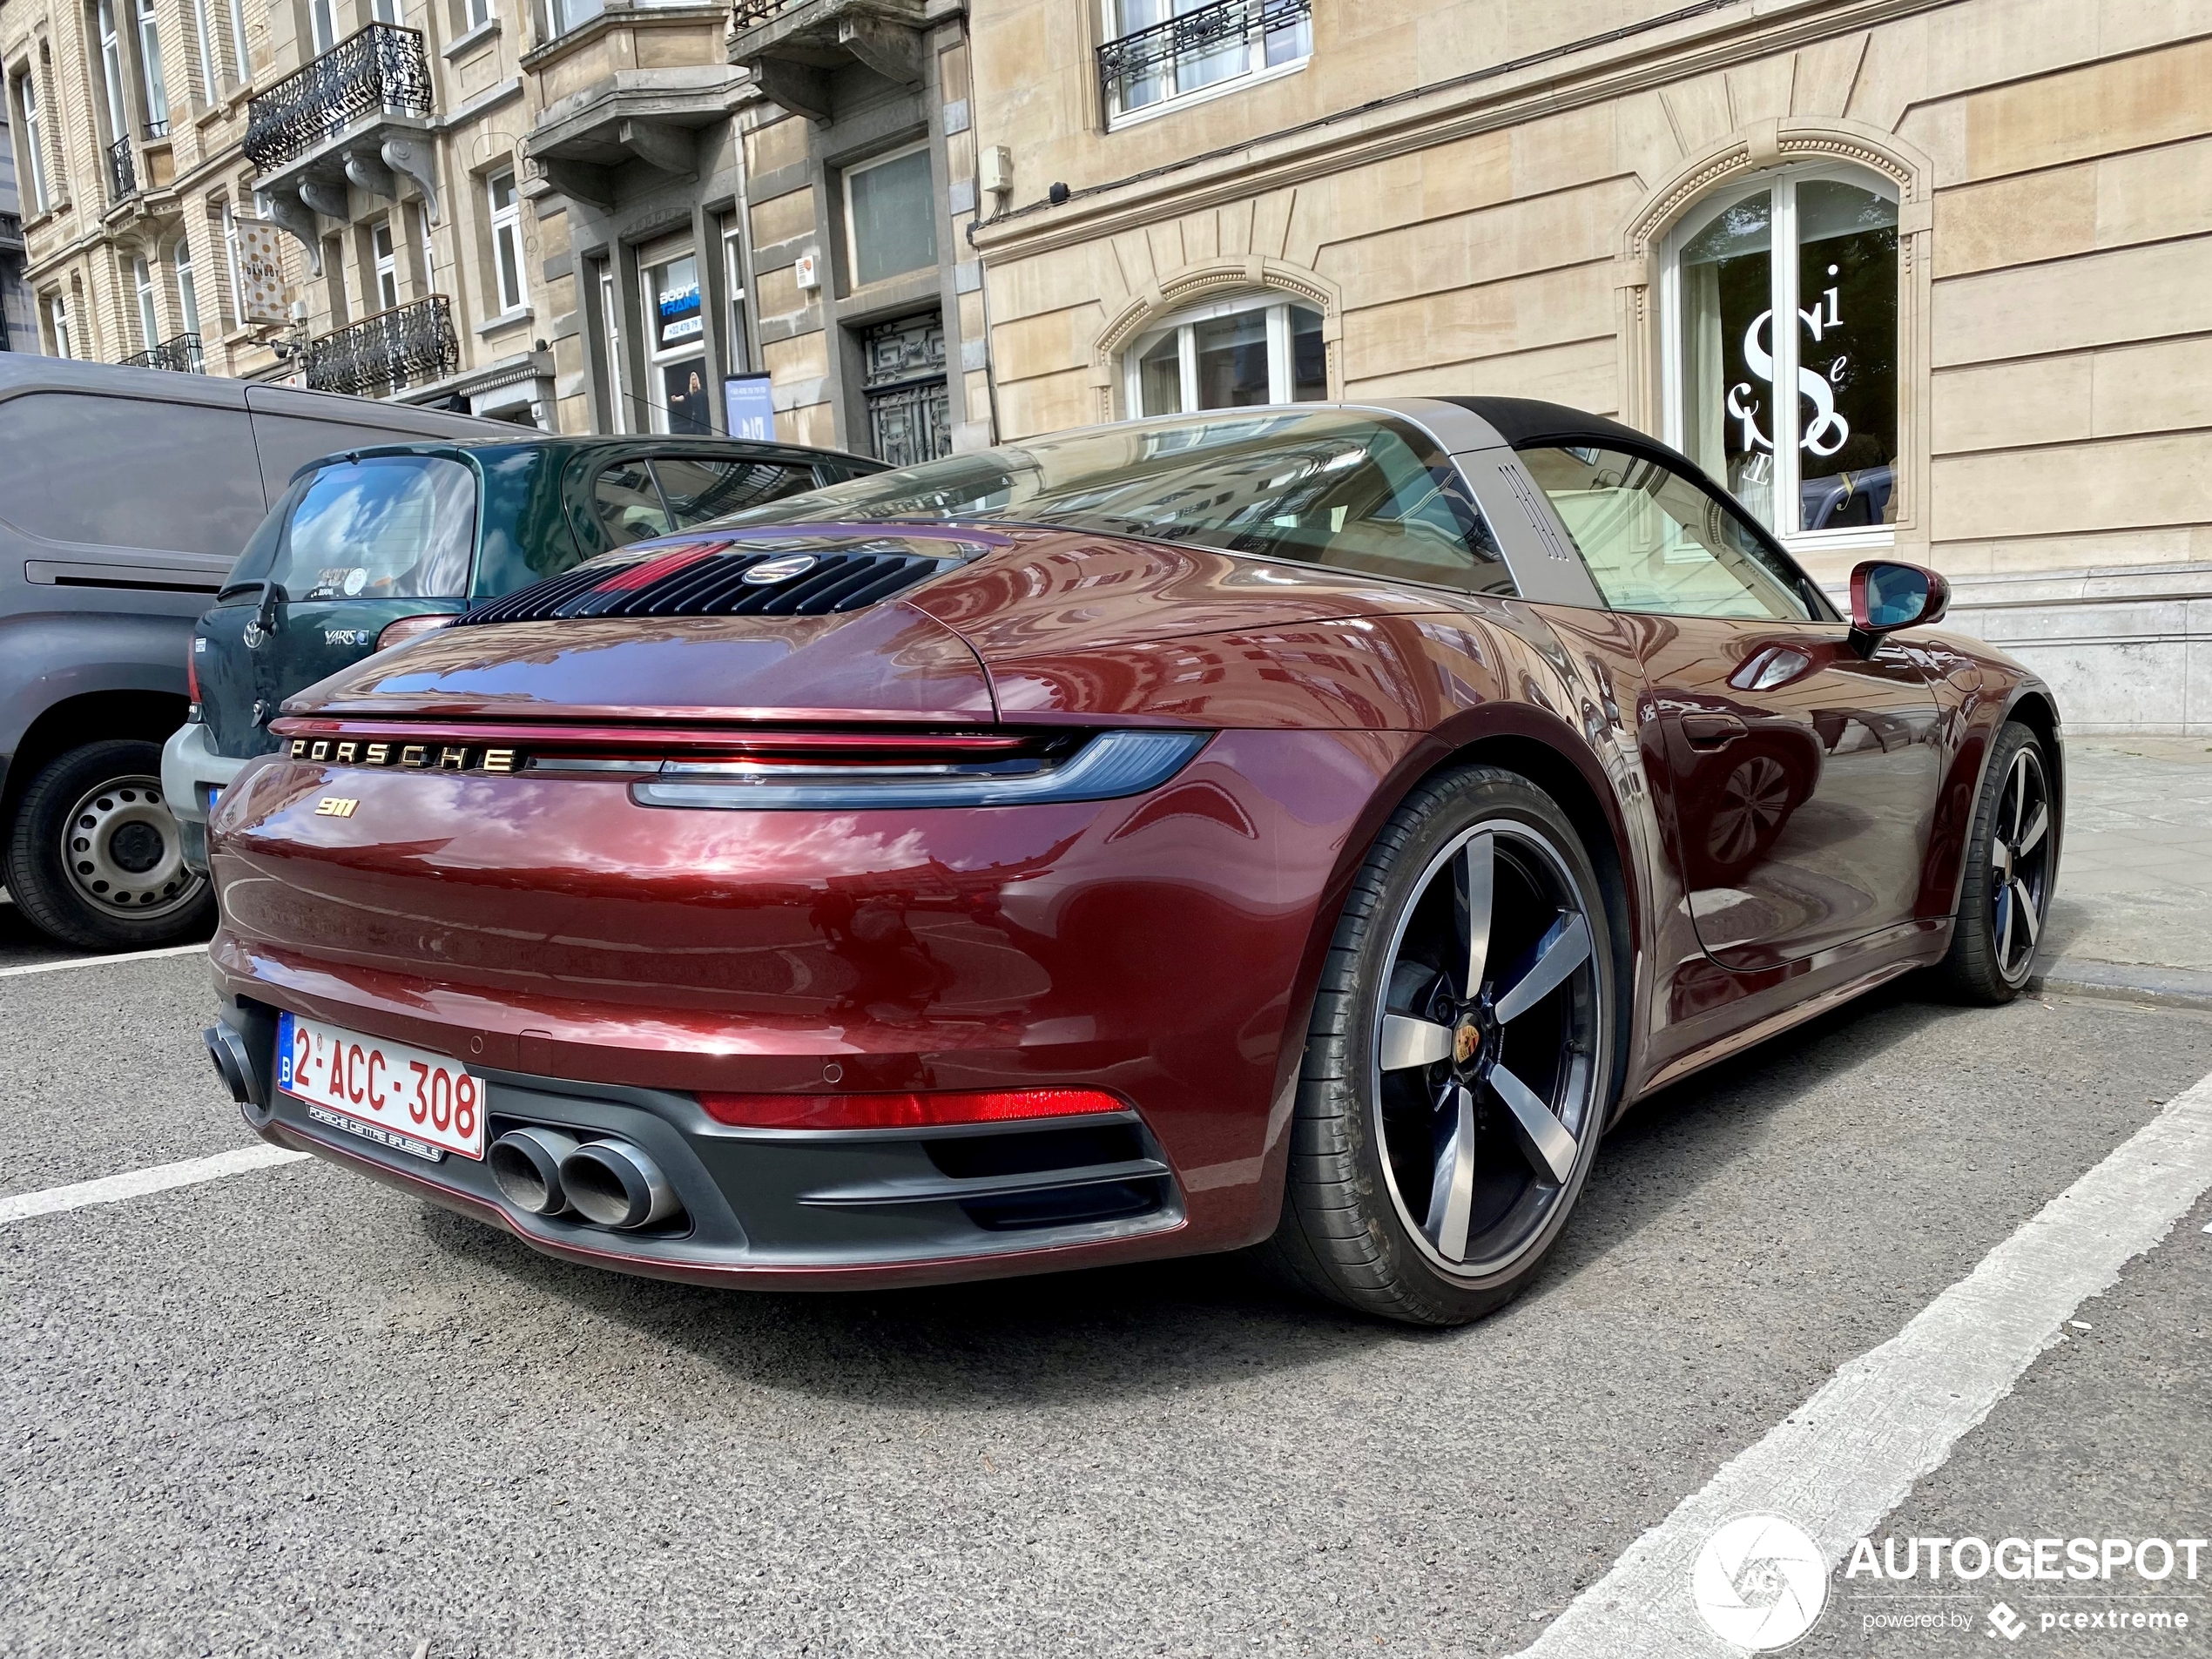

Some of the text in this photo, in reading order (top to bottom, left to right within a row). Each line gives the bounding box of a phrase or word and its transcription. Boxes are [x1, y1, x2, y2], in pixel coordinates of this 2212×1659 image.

[246, 265, 279, 278] DANDOY
[660, 284, 691, 305] BODY
[324, 630, 357, 645] YARIS
[290, 739, 516, 772] PORSCHE
[314, 796, 361, 819] 911
[281, 1055, 291, 1082] B
[309, 1106, 439, 1161] PORSCHE CENTRE BRUSSELS
